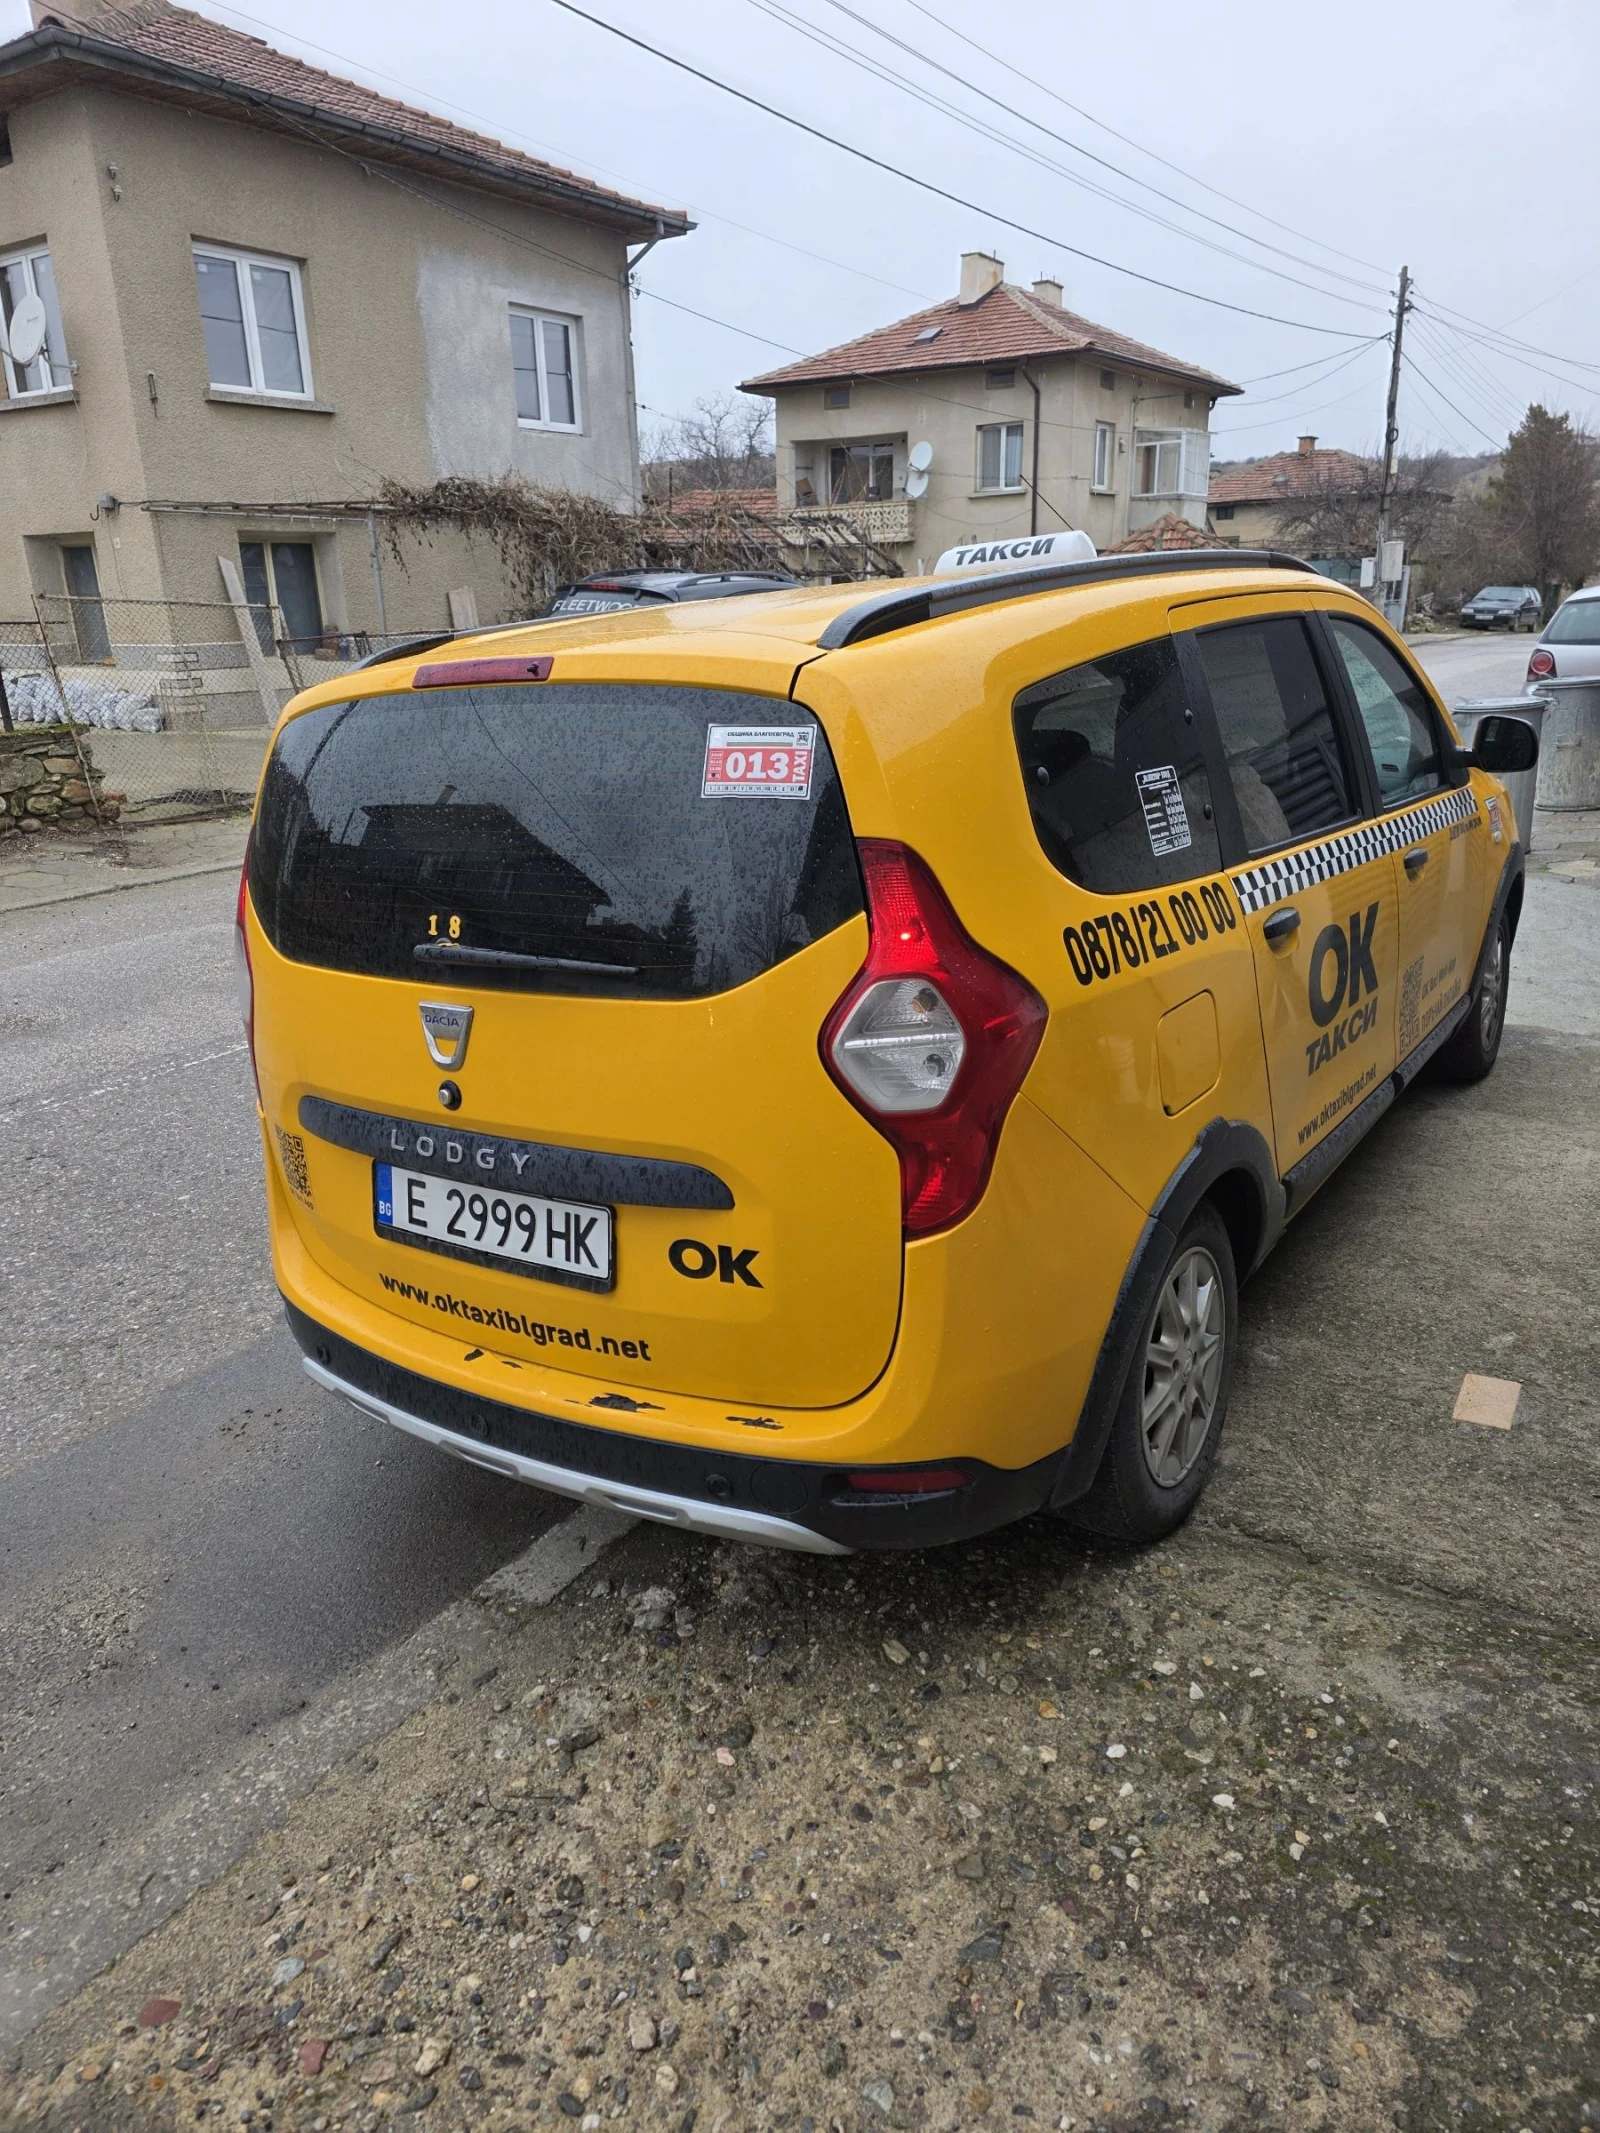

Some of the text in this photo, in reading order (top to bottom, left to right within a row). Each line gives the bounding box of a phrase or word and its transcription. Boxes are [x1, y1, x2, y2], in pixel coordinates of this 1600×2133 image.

[956, 537, 1056, 566] ТАКСИ
[551, 599, 641, 612] FLEETWOO
[725, 751, 790, 780] 013
[792, 750, 808, 782] TAXI
[1063, 882, 1237, 986] 0878/21 00 00
[1308, 901, 1380, 1028] OK
[424, 1014, 460, 1028] DACIA
[1306, 996, 1379, 1077] ТАКСИ
[1298, 1063, 1377, 1146] www.oktaxiblgrad.net
[390, 1129, 531, 1175] LODGY
[378, 1200, 392, 1217] BG
[407, 1177, 599, 1269] E 2999 HK
[668, 1238, 766, 1288] OK
[379, 1272, 652, 1362] www.oktaxiblgrad.net
